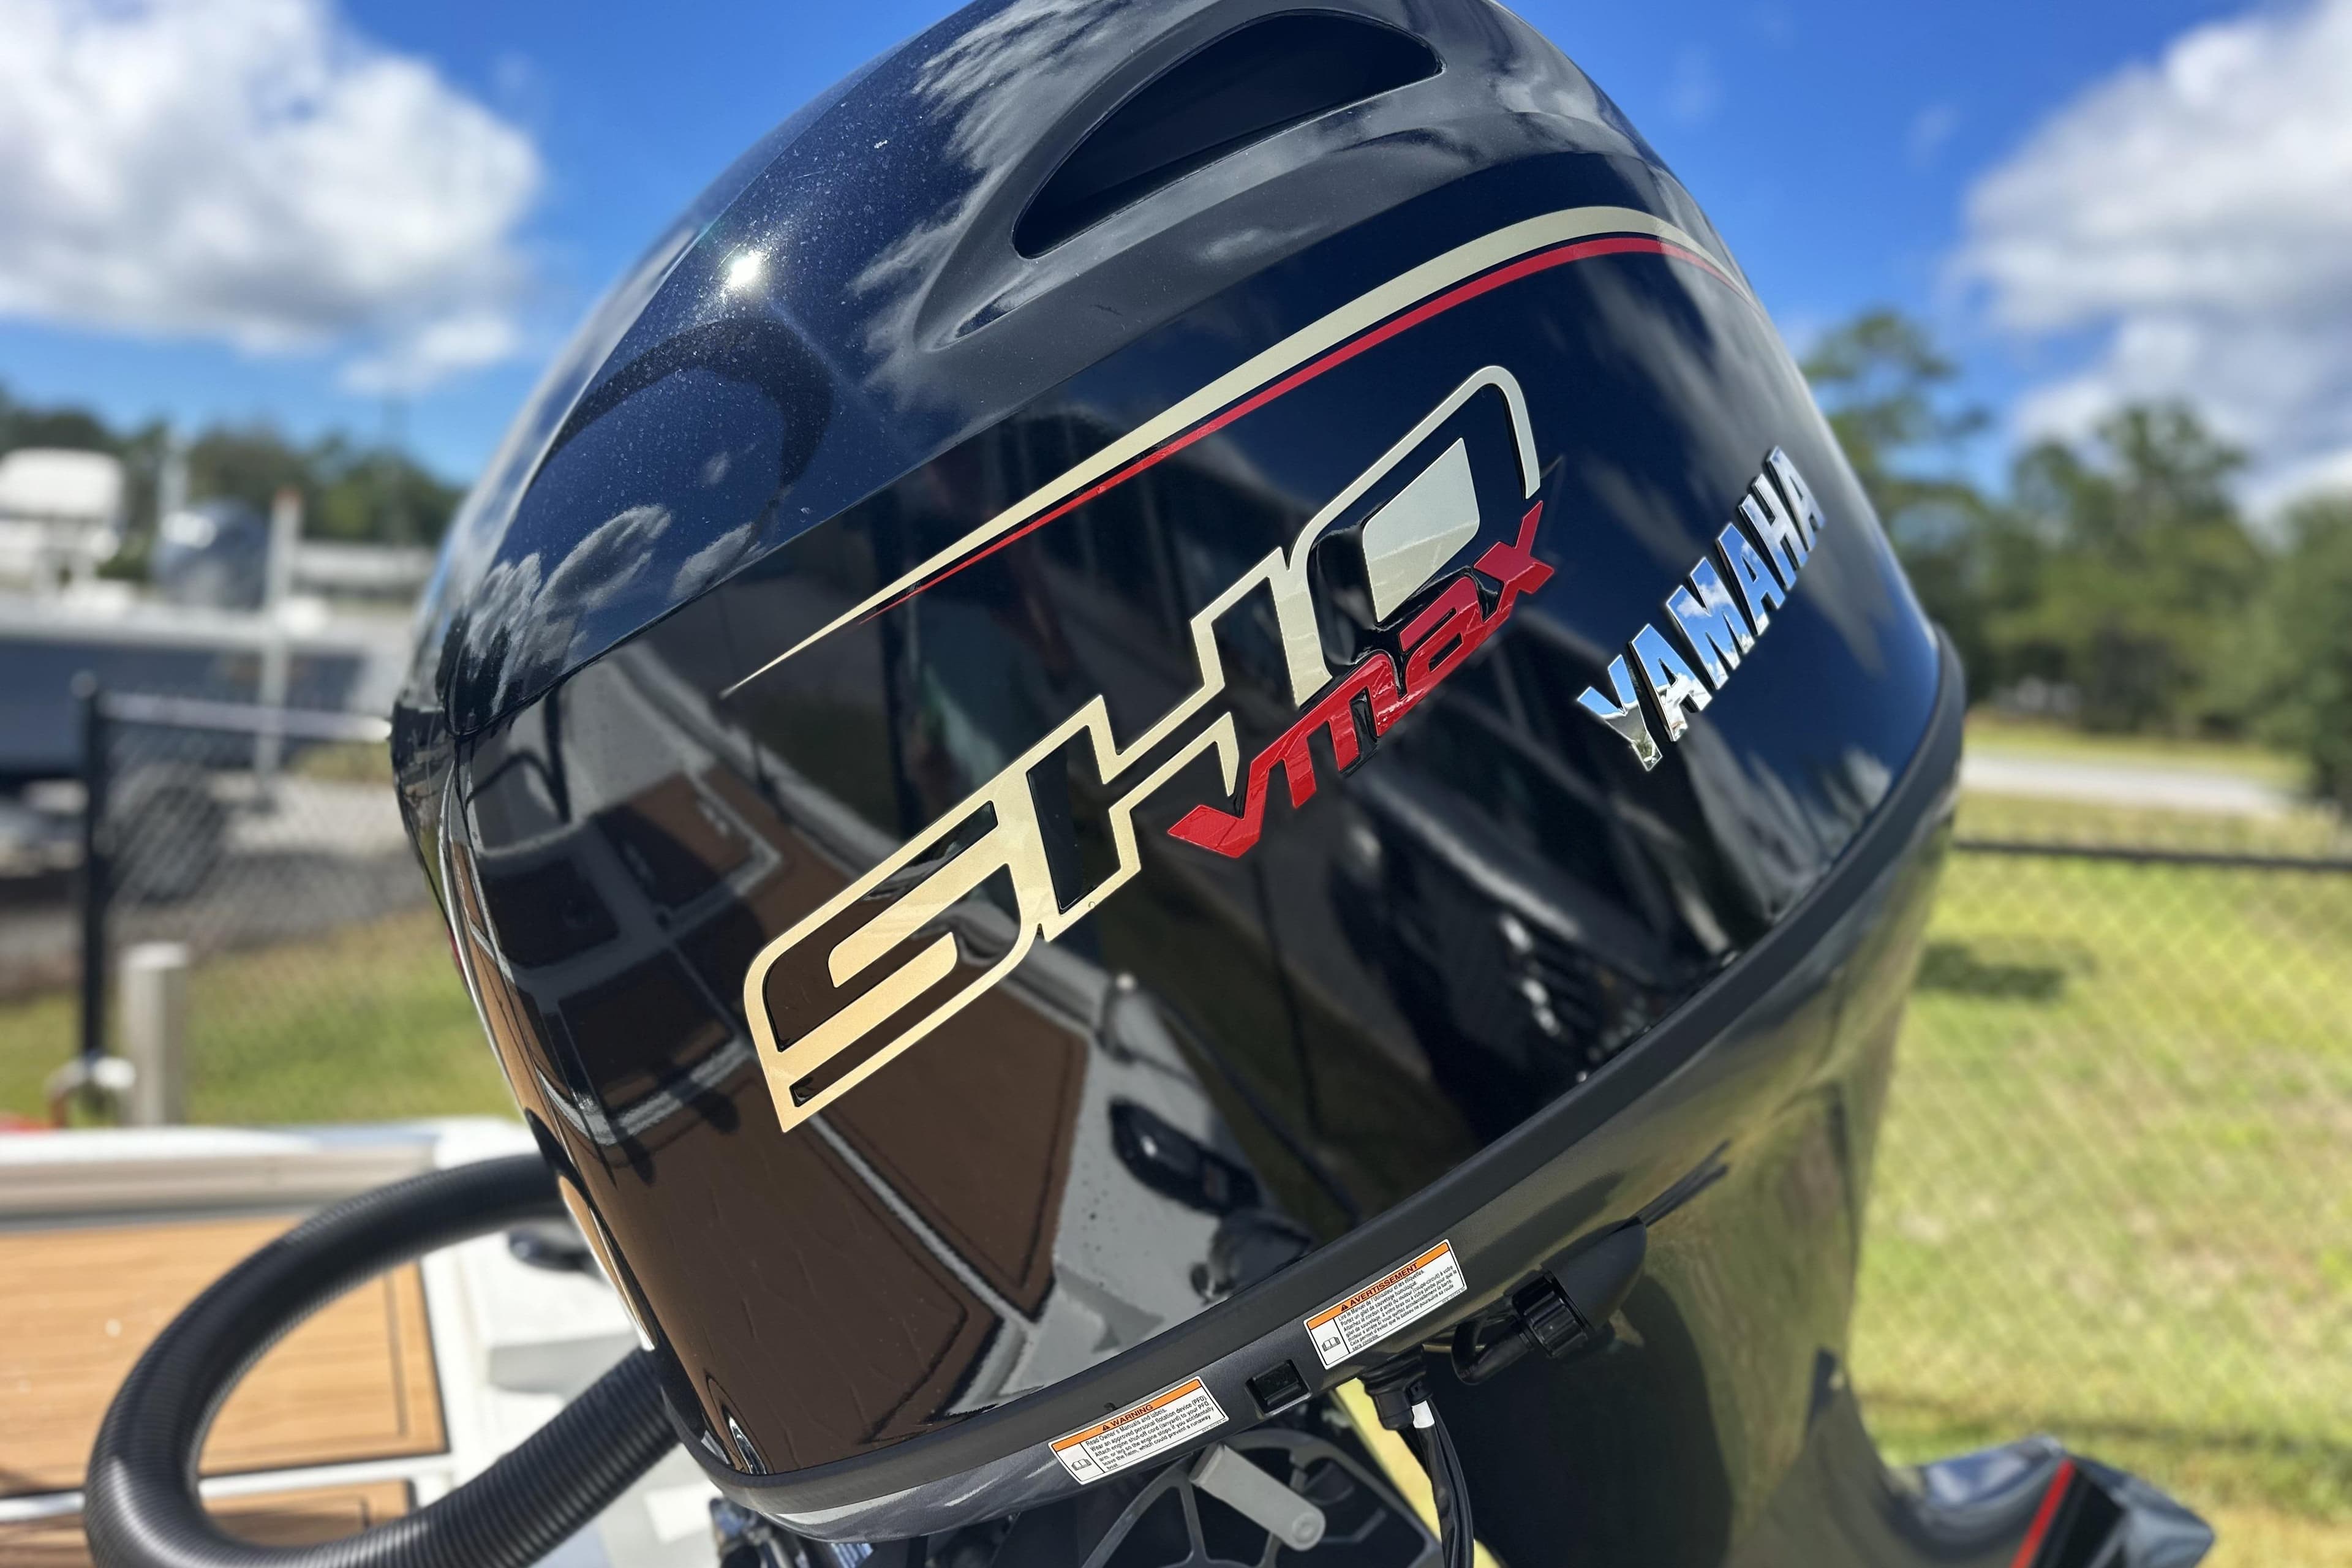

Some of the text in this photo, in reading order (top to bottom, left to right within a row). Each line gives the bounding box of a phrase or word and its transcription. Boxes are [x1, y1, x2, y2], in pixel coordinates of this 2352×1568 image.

[1577, 445, 1826, 772] YAMAHA
[1342, 1318, 1361, 1332] Attachez
[1397, 1289, 1412, 1301] moteur
[1442, 1264, 1453, 1274] votre
[1349, 1262, 1419, 1306] AVERTISSEMENT
[1337, 1313, 1347, 1322] Lire
[1350, 1302, 1366, 1314] Manuel
[1340, 1315, 1354, 1327] Portez
[1373, 1292, 1395, 1309] sauvetage
[1084, 1437, 1099, 1446] Read
[1119, 1419, 1141, 1432] Manuals
[1139, 1414, 1151, 1423] and
[1149, 1406, 1167, 1418] labels.
[1089, 1442, 1104, 1452] Wear
[1109, 1429, 1135, 1444] approved
[1133, 1419, 1156, 1434] personal
[1154, 1409, 1175, 1423] flotation
[1174, 1401, 1192, 1413] device
[1093, 1447, 1112, 1457] Attach
[1110, 1439, 1129, 1451] engine
[1127, 1430, 1148, 1442] shut-off
[1145, 1425, 1159, 1434] cord
[1158, 1414, 1182, 1430] (lanyard)
[1186, 1407, 1199, 1416] your
[1109, 1403, 1154, 1427] WARNING
[1139, 1433, 1158, 1445] engine
[1156, 1425, 1172, 1437] stops
[1175, 1420, 1186, 1428] you
[1184, 1405, 1215, 1423] accidentally
[1101, 1457, 1117, 1466] leave
[1137, 1441, 1154, 1450] which
[1152, 1434, 1167, 1444] could
[1166, 1425, 1187, 1438] prevent
[1189, 1414, 1212, 1428] runaway
